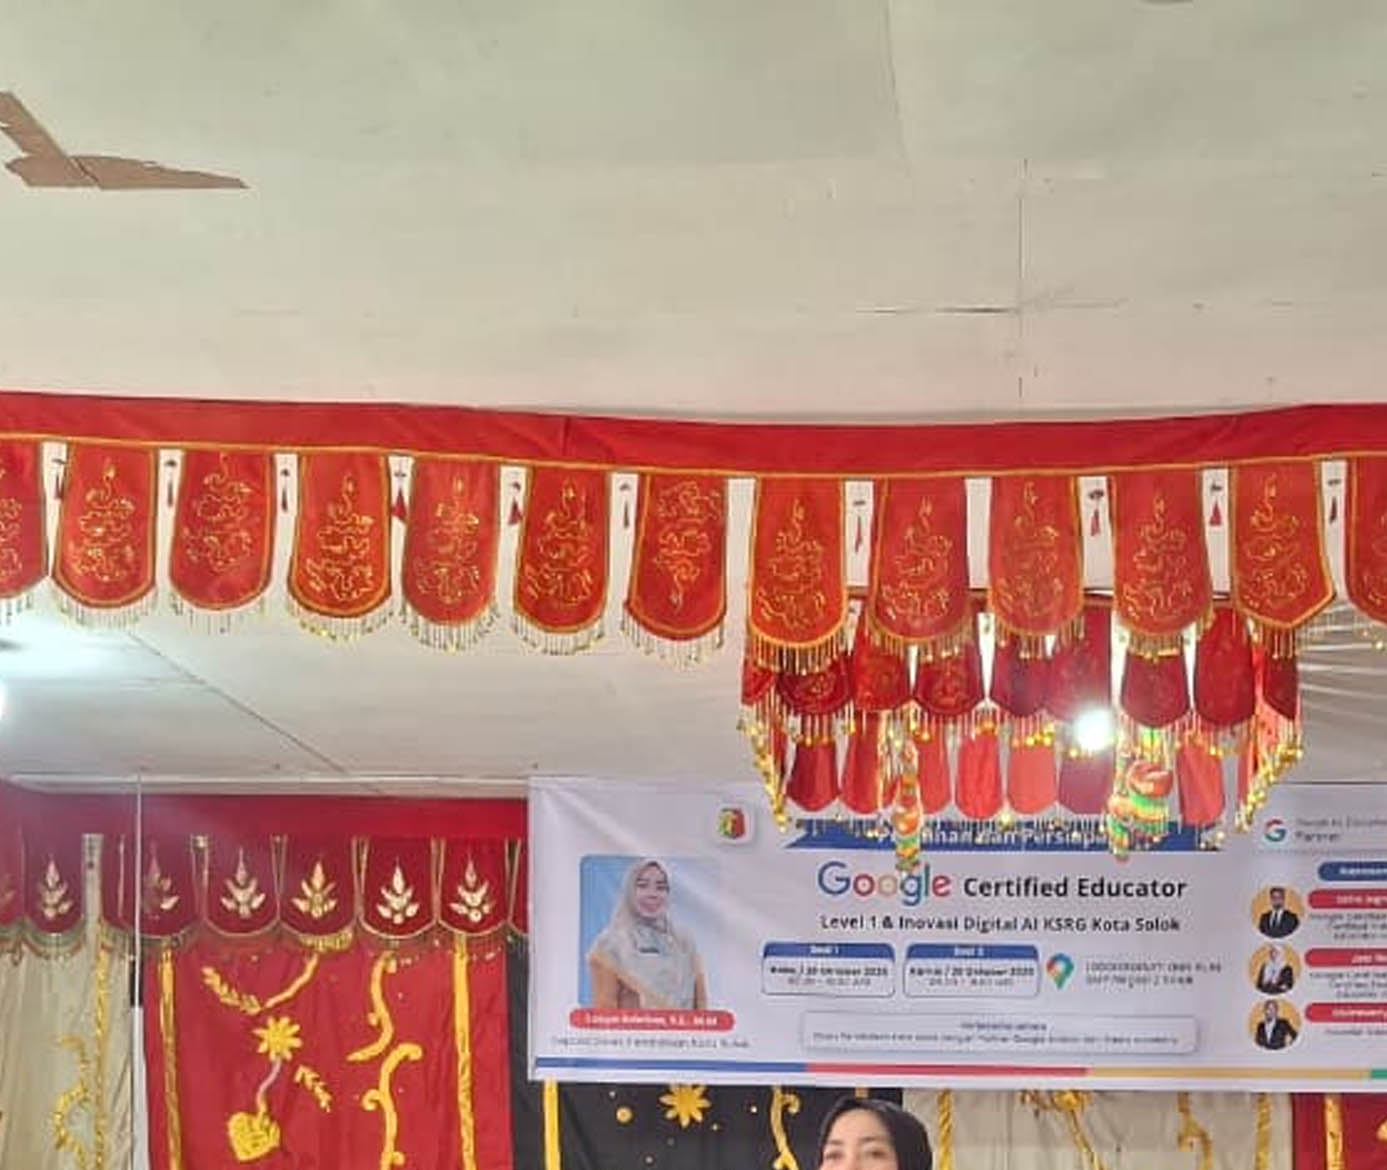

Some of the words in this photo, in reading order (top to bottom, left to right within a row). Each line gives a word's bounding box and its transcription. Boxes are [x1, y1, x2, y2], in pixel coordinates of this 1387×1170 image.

[816, 861, 951, 906] Google
[964, 876, 1068, 897] Certified
[1077, 876, 1188, 897] Educator
[820, 915, 864, 930] Level
[870, 915, 877, 930] 1
[882, 916, 893, 930] &
[899, 915, 958, 931] Inovasi
[964, 916, 1017, 934] Digital
[1092, 918, 1131, 932] Kota
[1136, 917, 1180, 932] Solok
